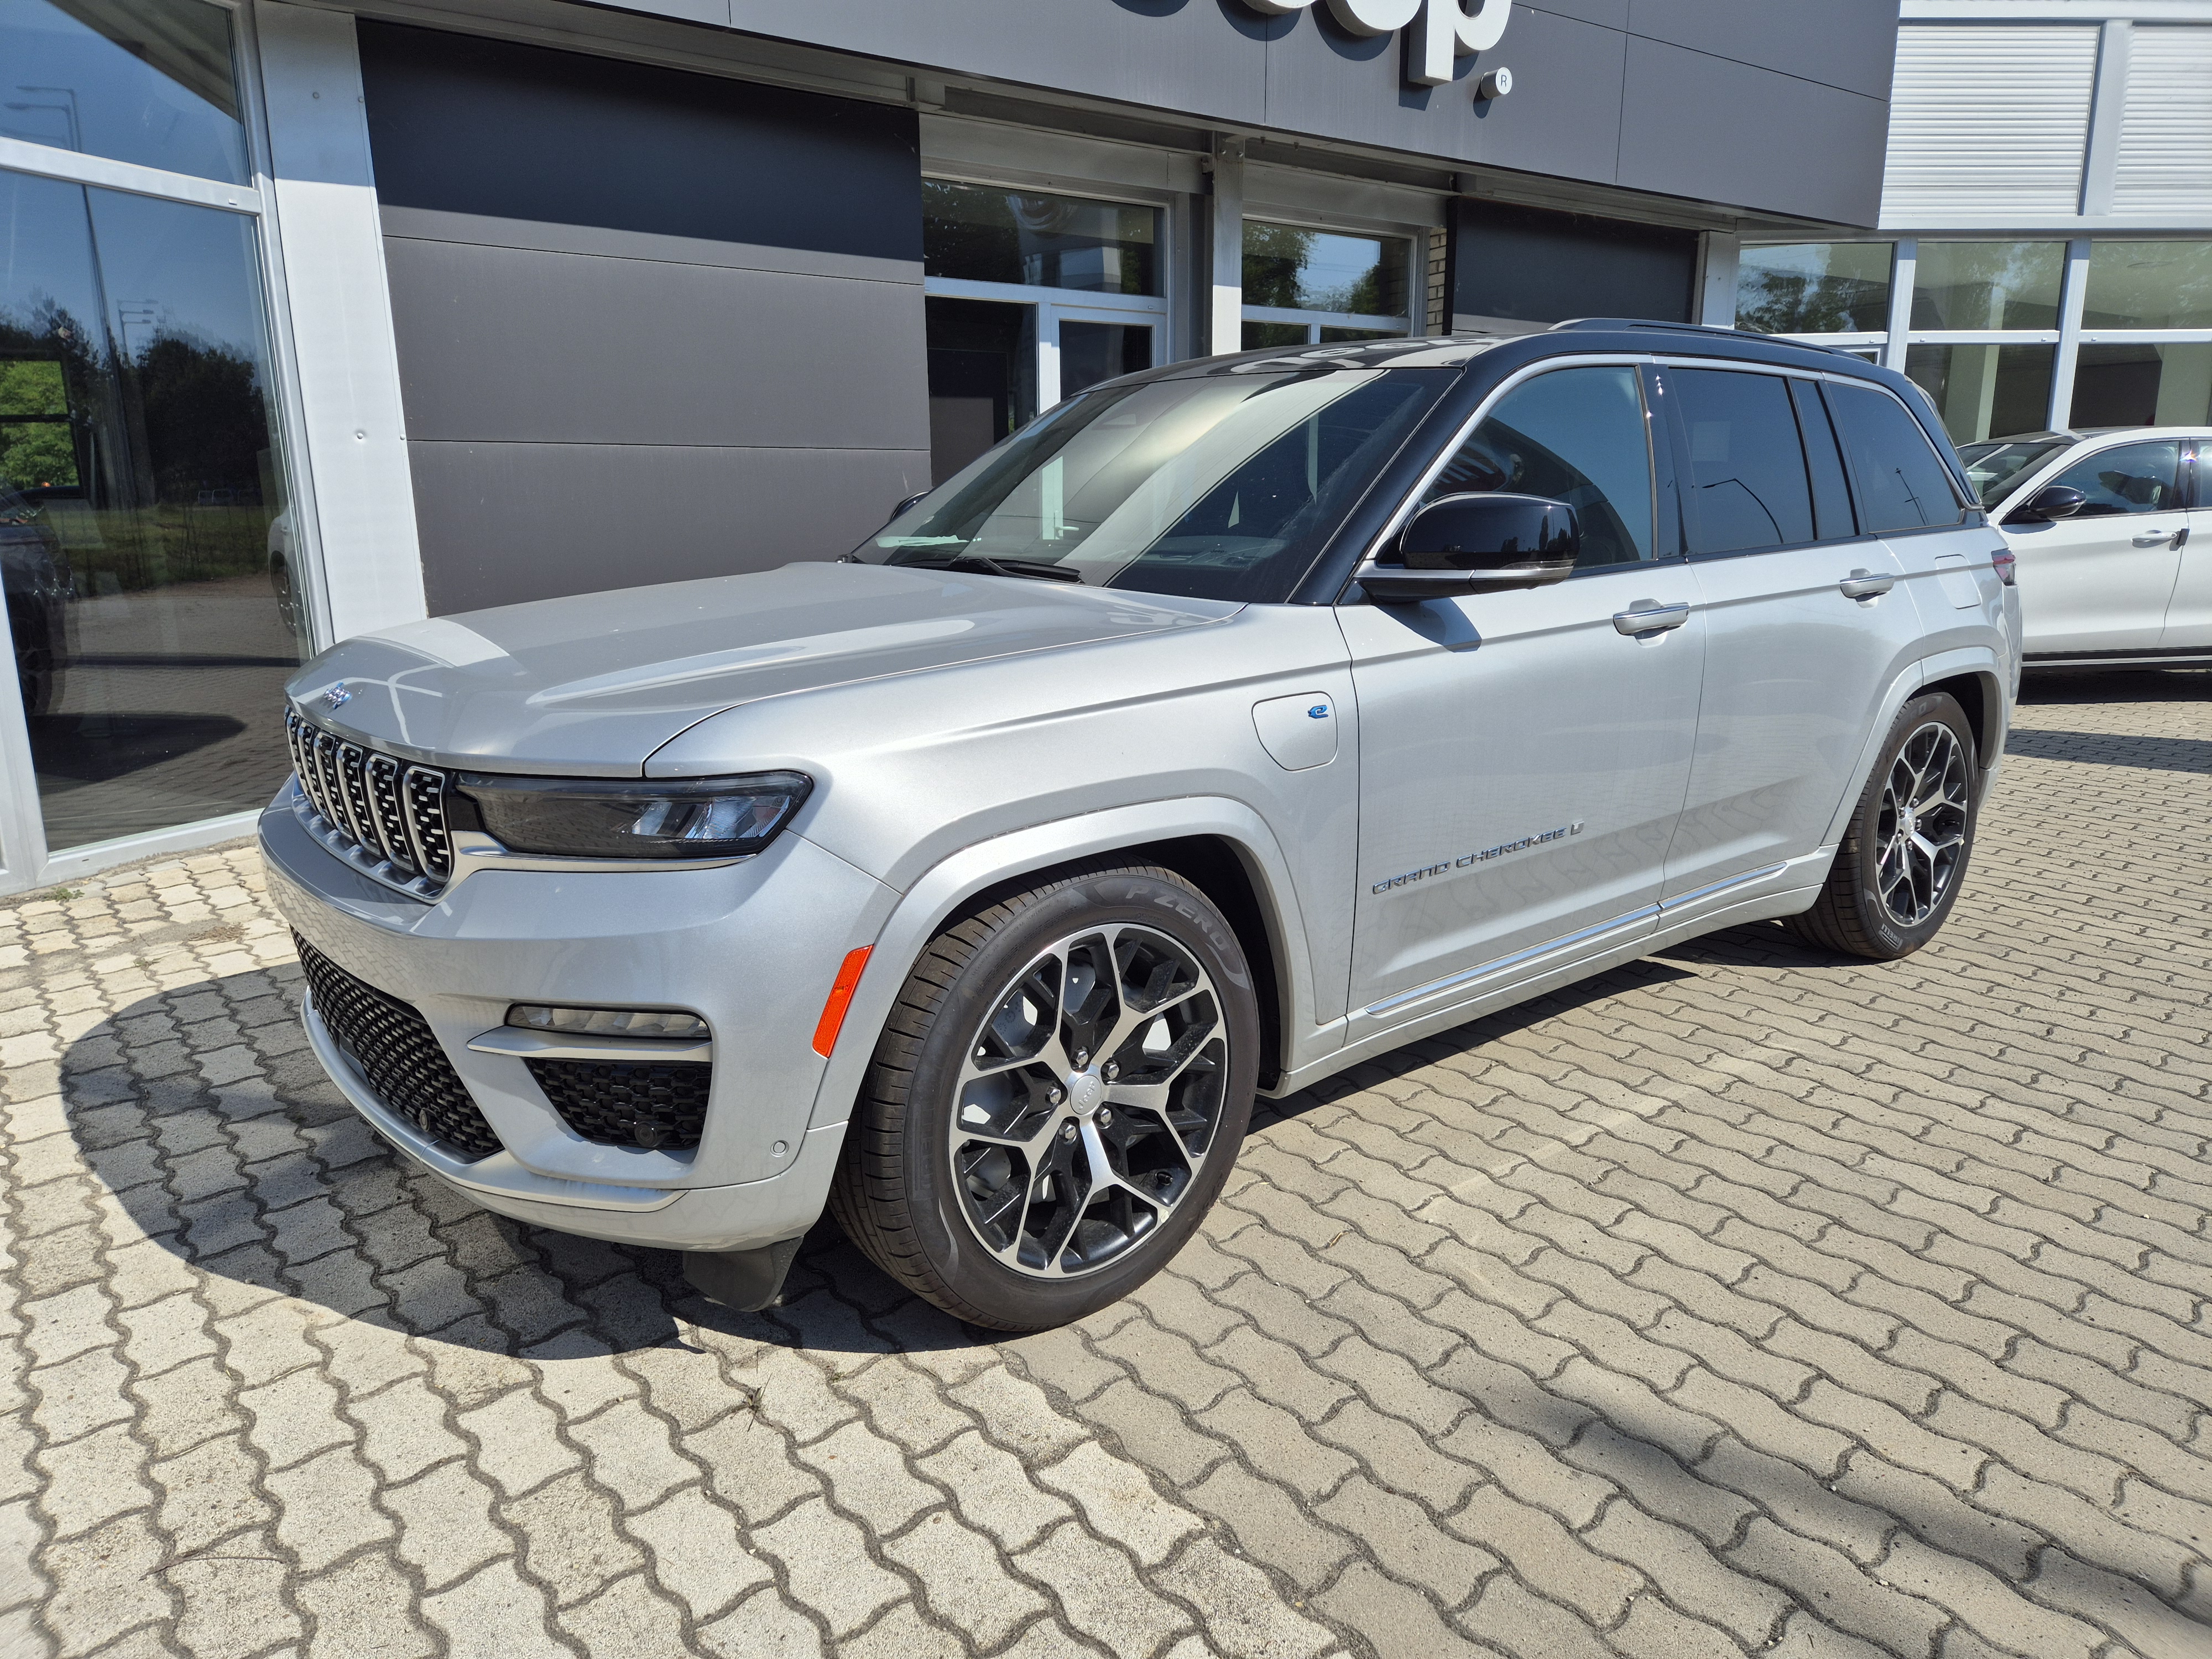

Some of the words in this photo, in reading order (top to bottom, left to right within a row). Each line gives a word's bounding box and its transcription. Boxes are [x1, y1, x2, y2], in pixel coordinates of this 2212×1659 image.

[1373, 861, 1451, 895] GRAND
[1456, 827, 1567, 868] CHEROKEE
[1126, 885, 1150, 899] P
[1154, 891, 1230, 951] ZERO
[1878, 923, 1903, 950] PIRELLI
[1078, 1081, 1095, 1110] Jeep
